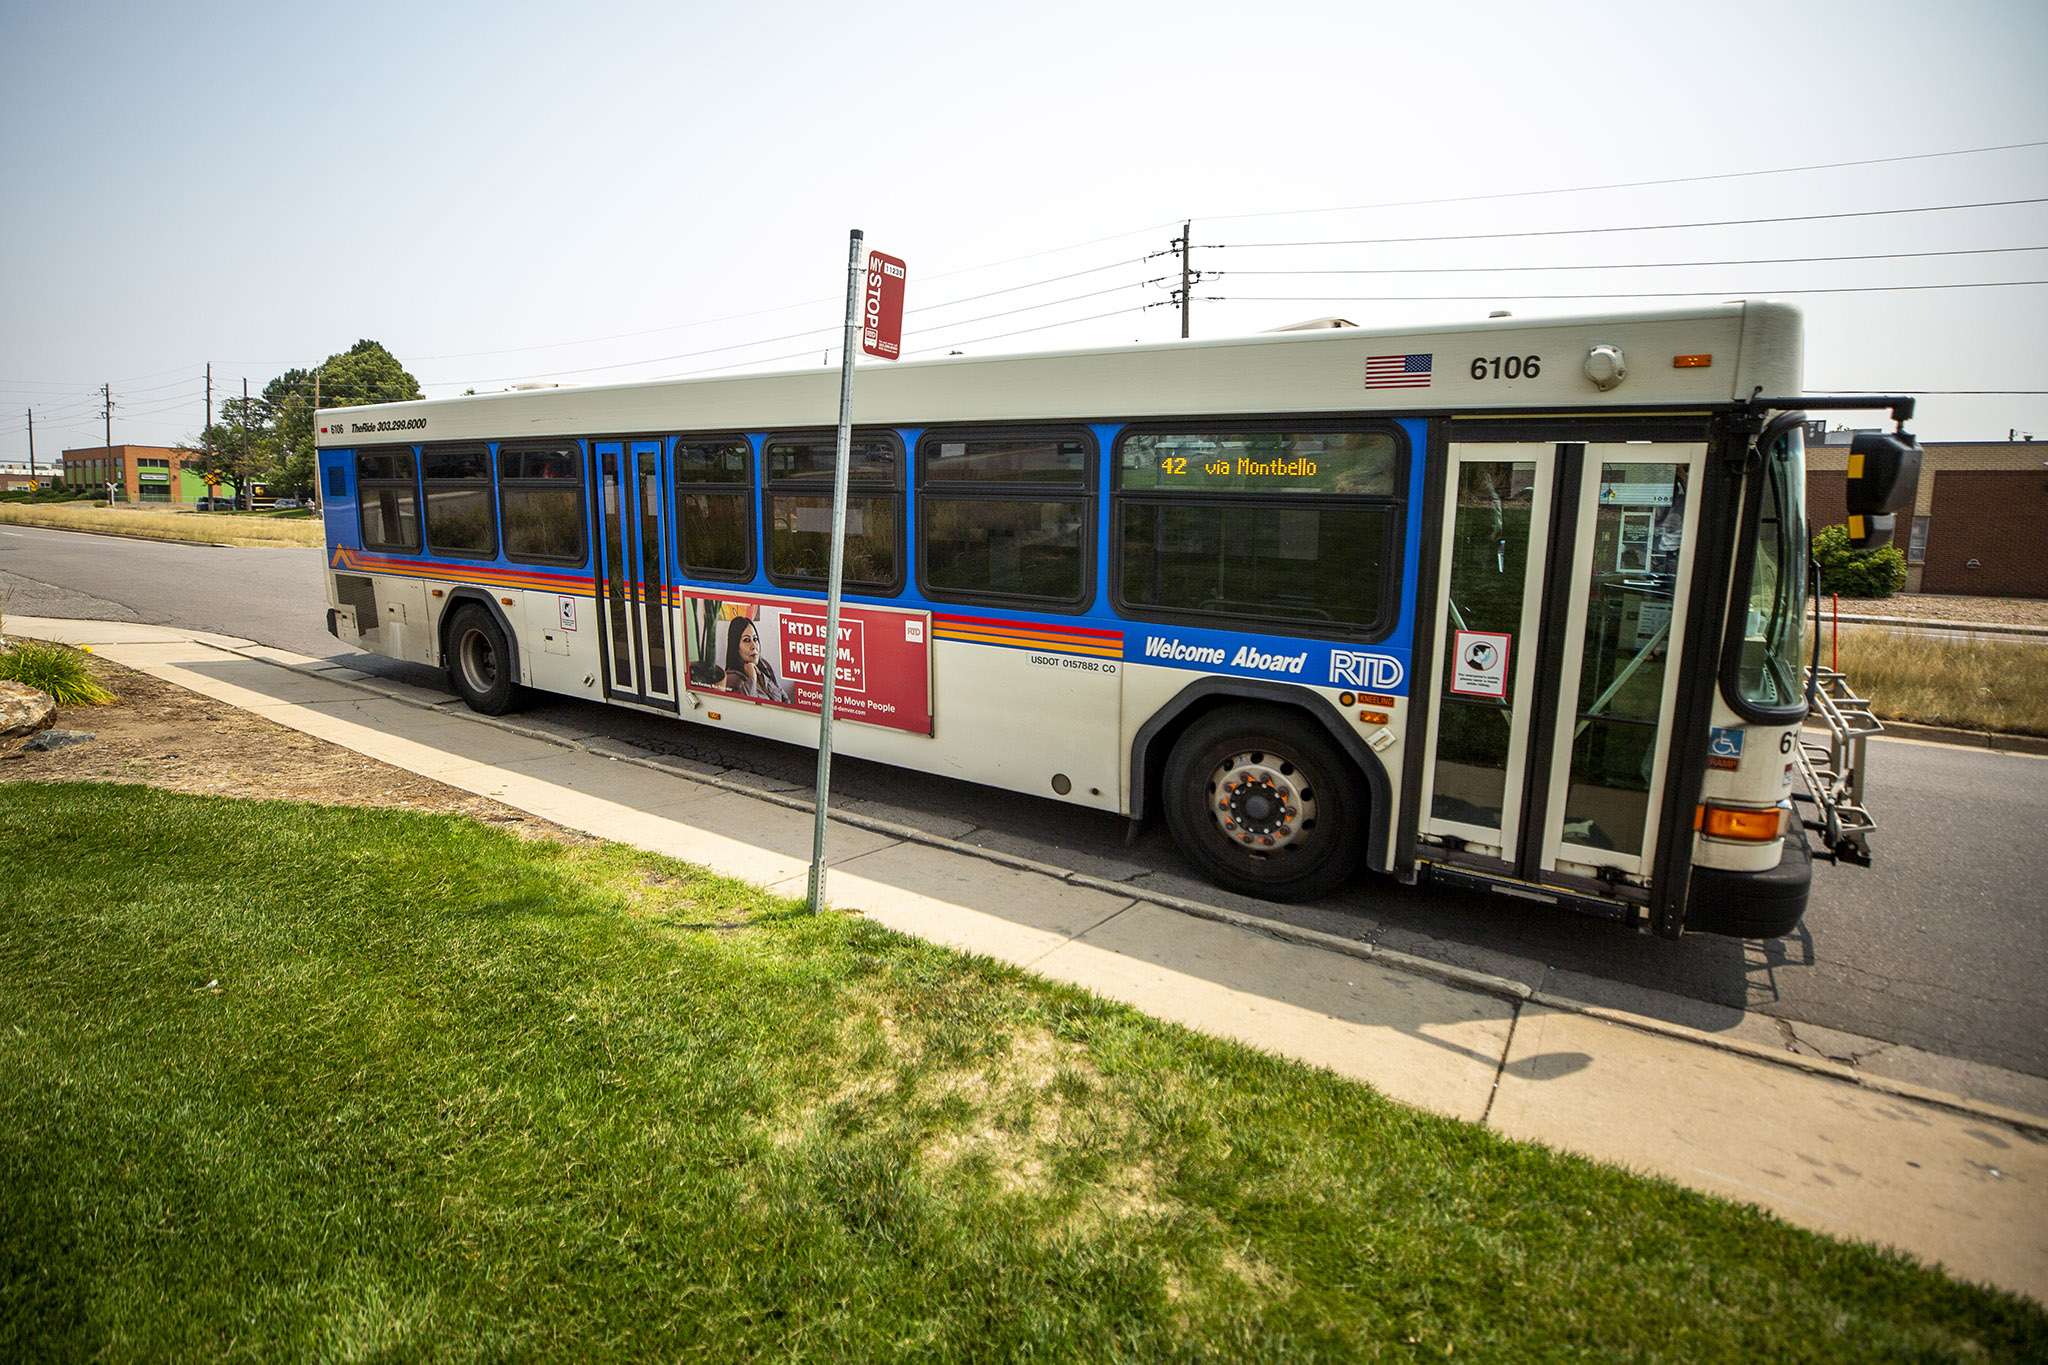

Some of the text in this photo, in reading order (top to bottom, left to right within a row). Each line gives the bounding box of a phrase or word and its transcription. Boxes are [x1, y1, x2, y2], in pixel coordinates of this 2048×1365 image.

[869, 256, 883, 273] MY
[866, 272, 882, 328] STOP
[1470, 355, 1541, 380] 6106
[330, 418, 427, 434] 6106 TheRide 303.299.6000
[1161, 457, 1317, 476] 42 via Montbello
[816, 625, 827, 638] IS
[907, 627, 921, 637] RTD
[789, 641, 854, 663] FREEDM,
[1144, 636, 1306, 674] Welcome Aboard
[790, 660, 861, 682] MY VCE.”
[1031, 655, 1116, 674] USDOT 0157882 CO
[1329, 649, 1404, 689] RTD
[798, 688, 823, 700] People
[844, 696, 866, 708] Move
[867, 700, 896, 713] People
[1360, 694, 1393, 706] KNEELING
[1710, 758, 1737, 768] RAMP
